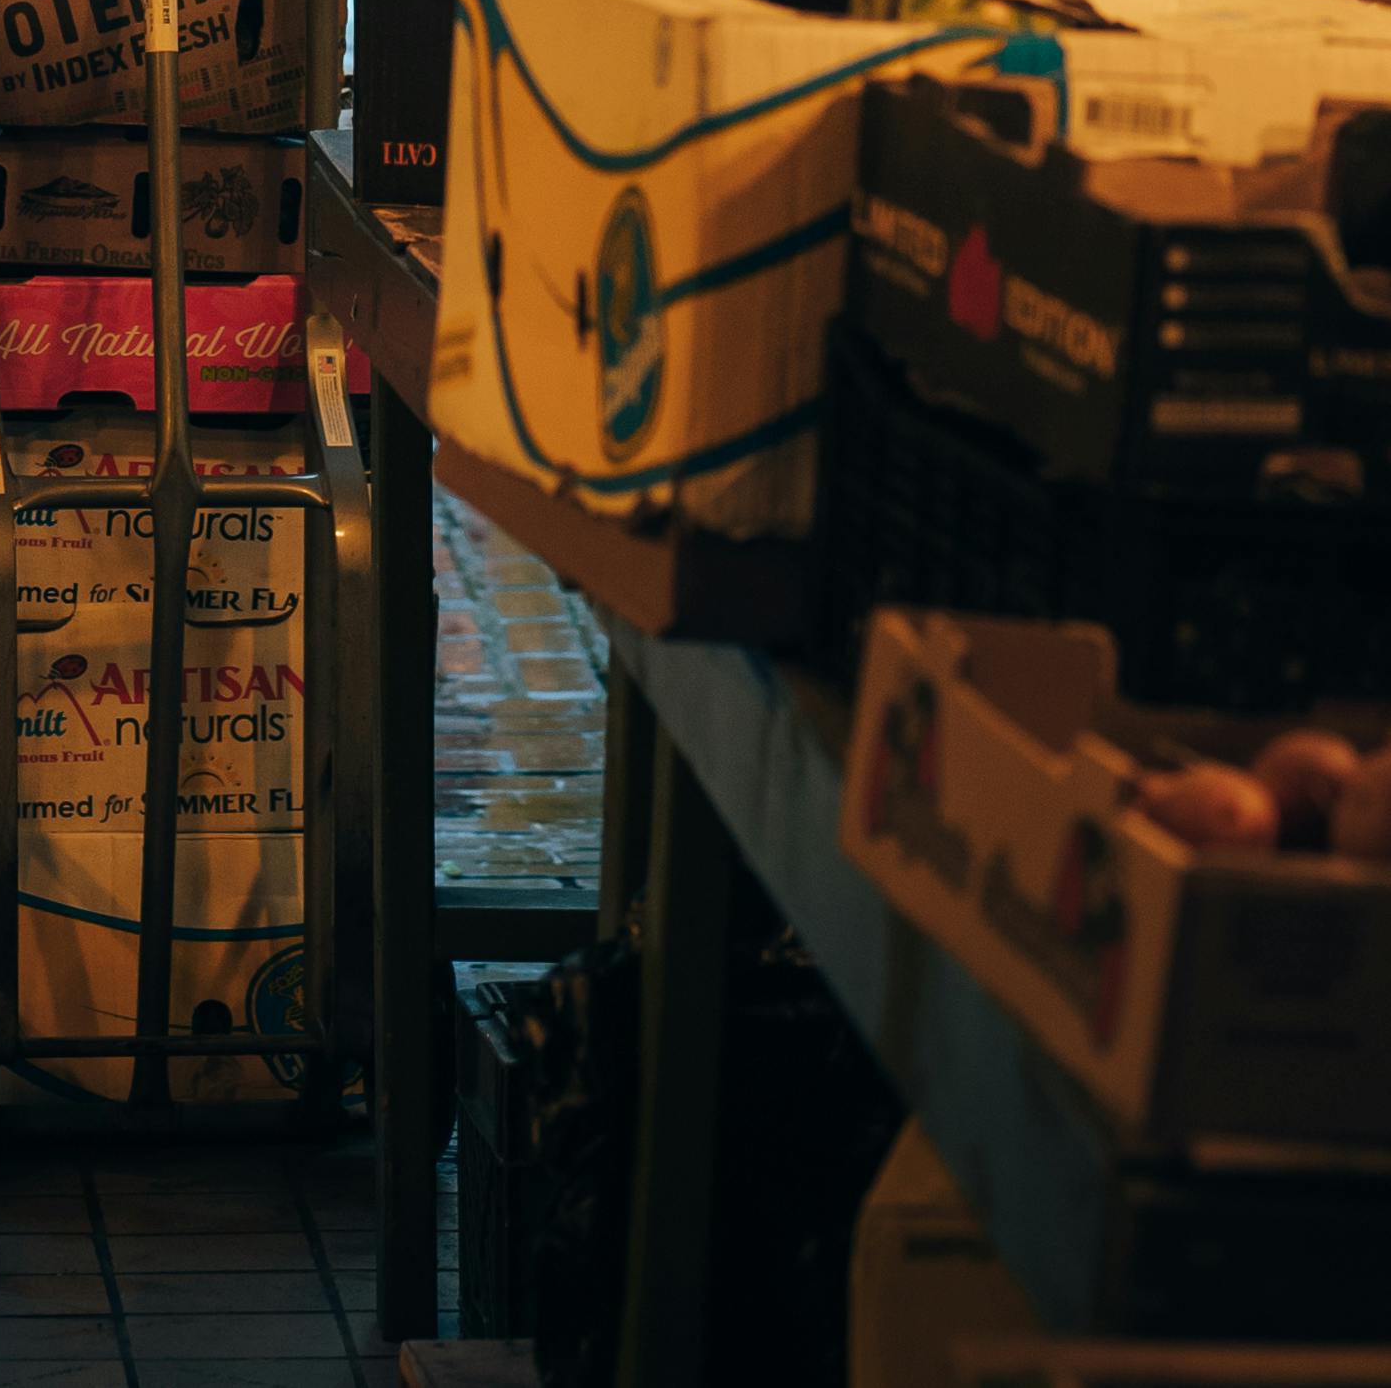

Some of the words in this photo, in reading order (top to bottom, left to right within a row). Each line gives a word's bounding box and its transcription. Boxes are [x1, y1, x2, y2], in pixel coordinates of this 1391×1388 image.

[2, 71, 26, 92] BY
[32, 46, 128, 93] INDEX
[131, 11, 231, 67] FESH
[25, 240, 84, 265] FRESH
[90, 242, 152, 268] ORGA
[183, 248, 227, 270] FIGS
[61, 320, 225, 364] Natual
[106, 506, 275, 543] naurals
[50, 535, 94, 551] Fruit
[88, 583, 117, 606] for
[61, 749, 105, 764] Fruit
[100, 795, 134, 824] for
